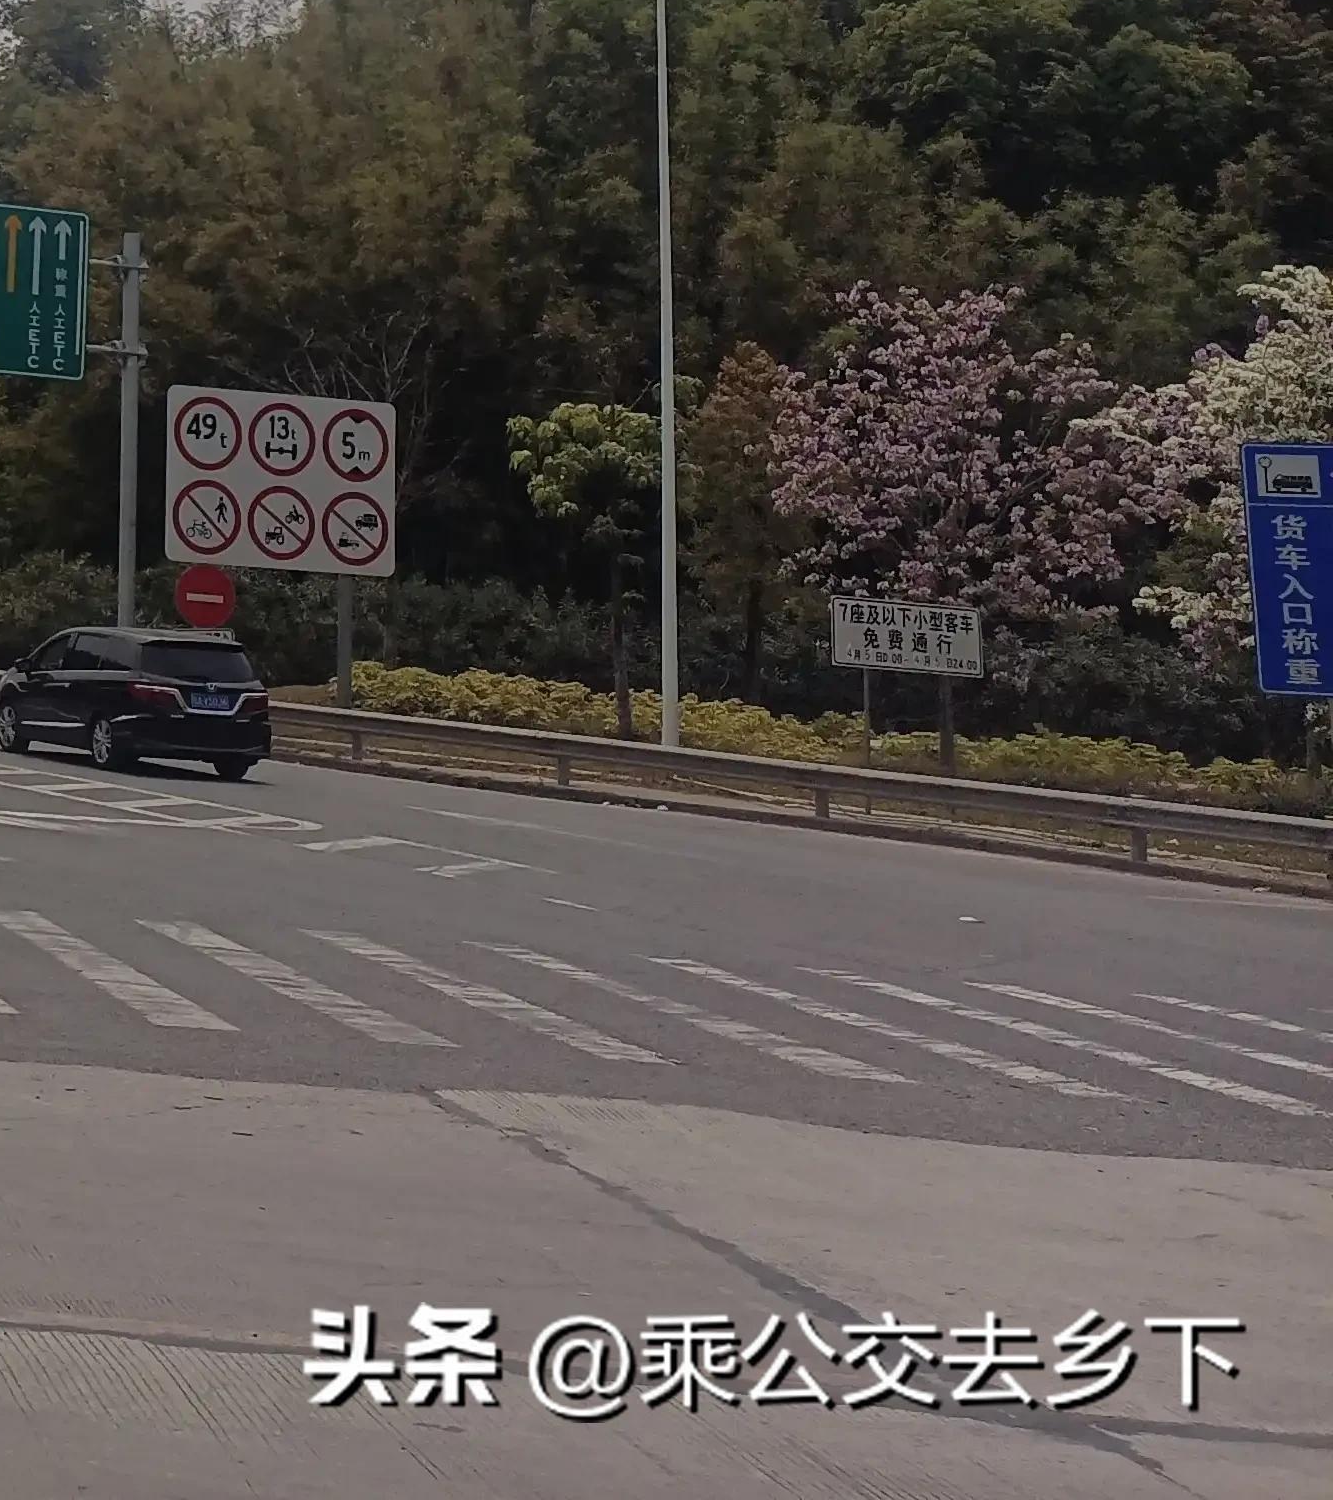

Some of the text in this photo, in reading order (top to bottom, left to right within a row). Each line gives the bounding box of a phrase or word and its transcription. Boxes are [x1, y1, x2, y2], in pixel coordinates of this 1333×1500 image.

[1270, 513, 1324, 686] 货车入口称重
[839, 603, 974, 635] 7座及以下小型客车
[863, 627, 953, 656] 免费通行
